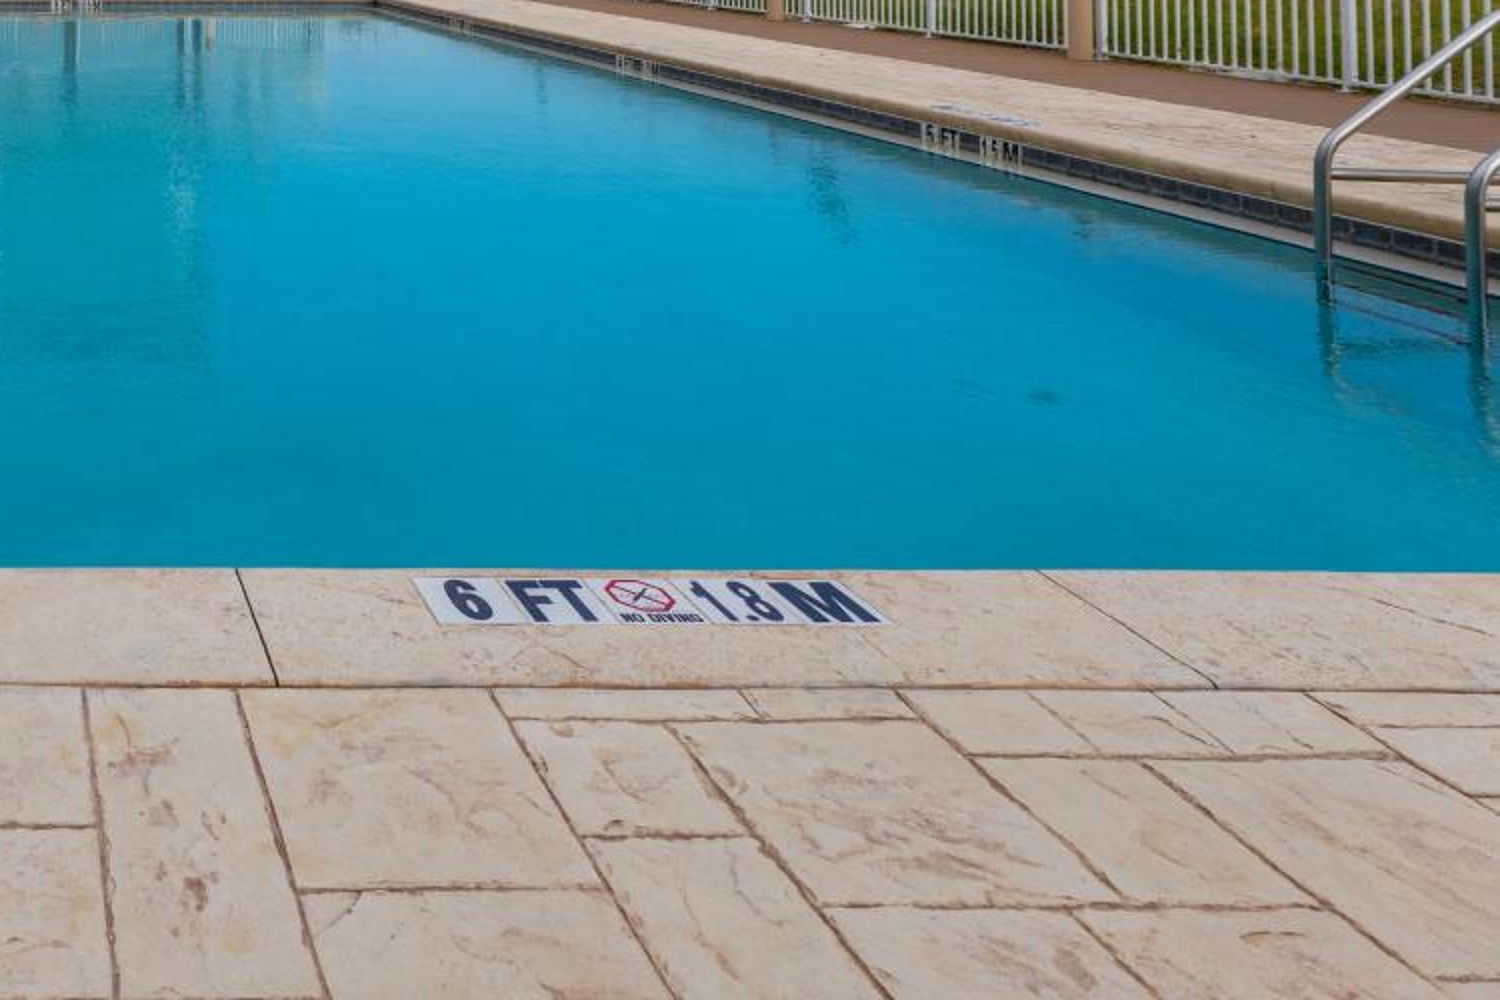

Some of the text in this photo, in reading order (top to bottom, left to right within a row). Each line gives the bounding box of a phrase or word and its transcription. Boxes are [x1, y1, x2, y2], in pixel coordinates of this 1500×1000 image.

[443, 579, 493, 621] 6
[505, 580, 599, 622] FT
[620, 613, 704, 623] NO DIVING
